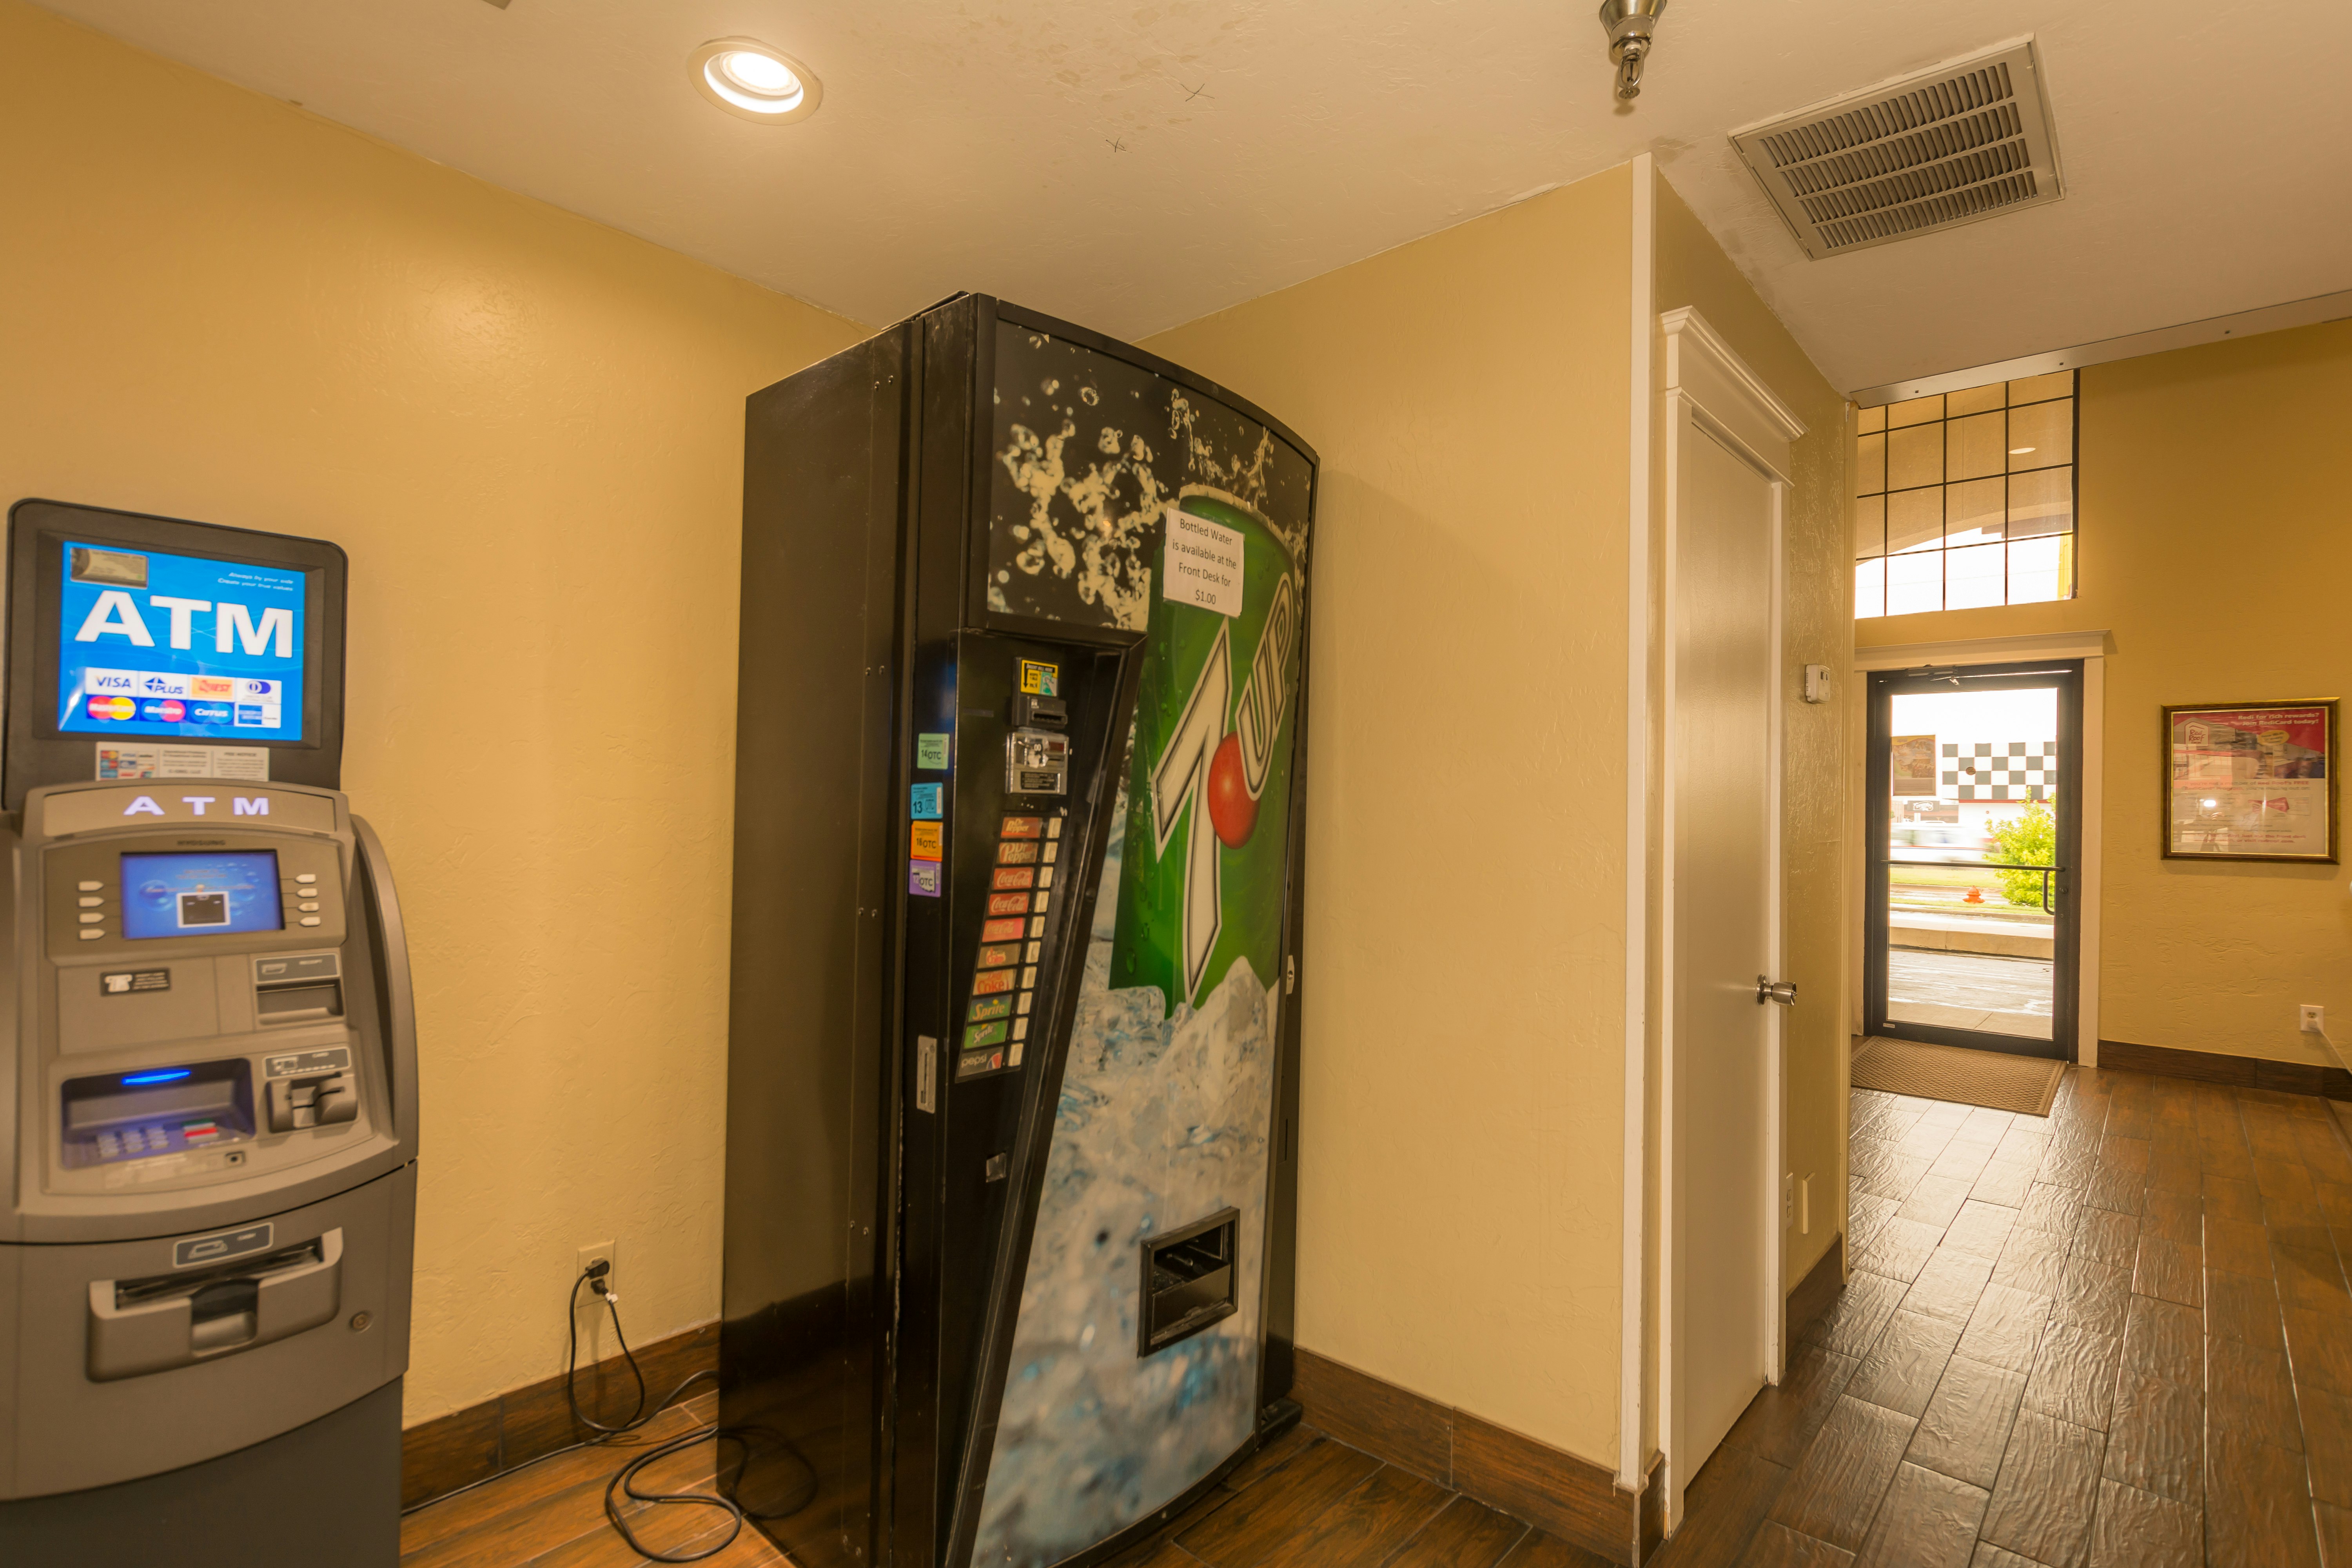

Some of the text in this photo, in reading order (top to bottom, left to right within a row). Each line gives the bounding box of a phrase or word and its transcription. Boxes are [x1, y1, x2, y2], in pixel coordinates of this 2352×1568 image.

[1180, 518, 1232, 545] Bottled Water
[1172, 539, 1236, 569] is available at the
[1179, 562, 1231, 587] Front Desk for
[1196, 589, 1216, 604] $1.00
[74, 590, 293, 658] ATM
[96, 677, 131, 688] VISA
[154, 685, 183, 695] PLUS
[194, 708, 229, 717] Cirrus
[927, 751, 942, 760] OTC
[913, 801, 922, 814] 13
[922, 840, 937, 849] OTC
[919, 878, 933, 887] OTC
[976, 980, 1005, 995] Coke
[972, 1002, 1005, 1021] Sprite
[961, 1053, 987, 1069] pepsi
